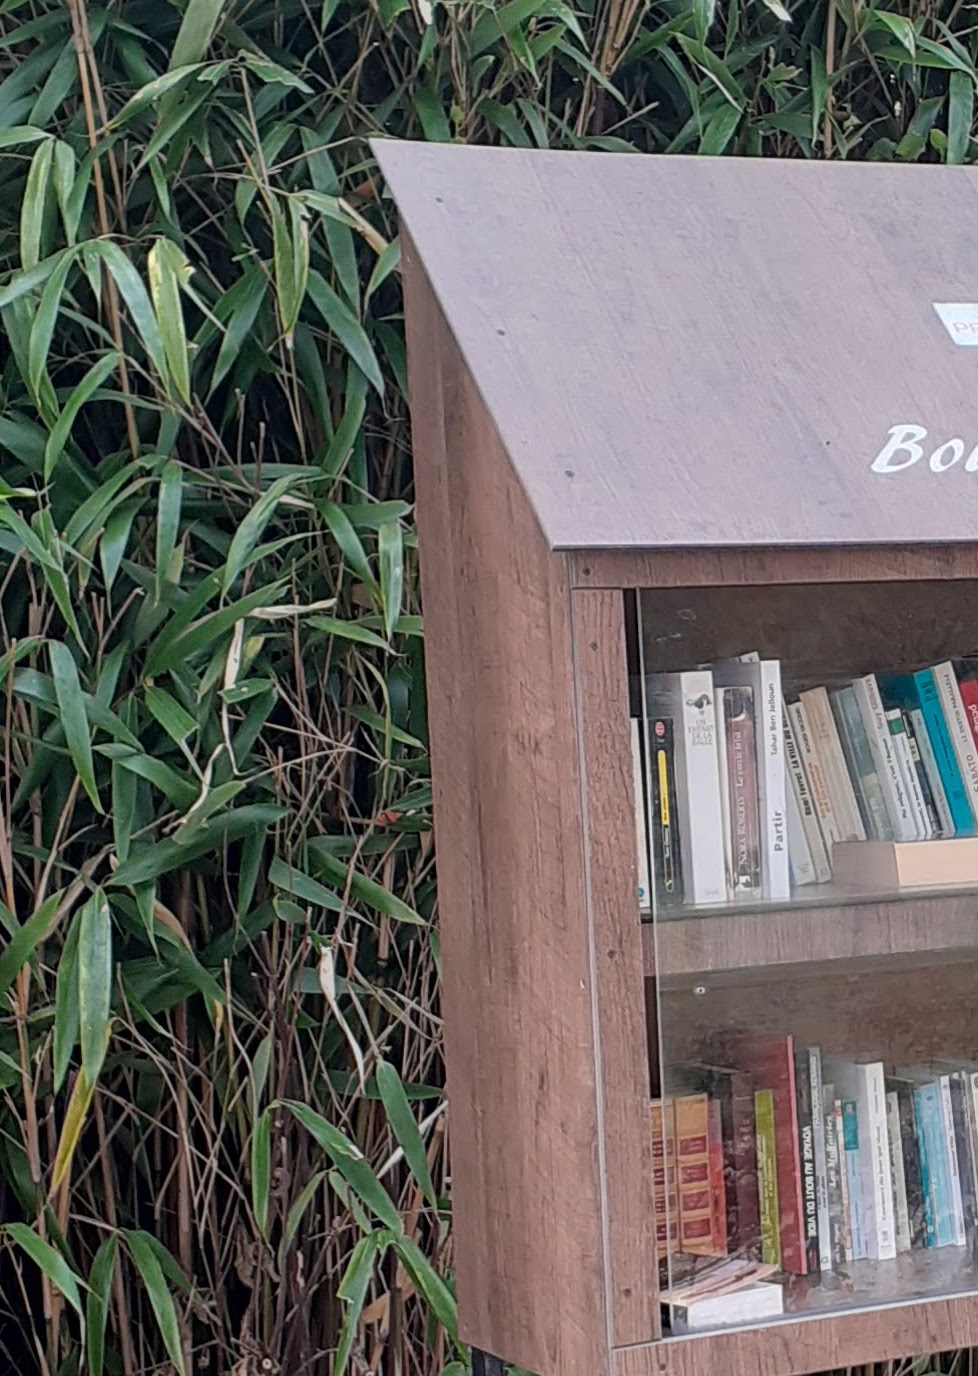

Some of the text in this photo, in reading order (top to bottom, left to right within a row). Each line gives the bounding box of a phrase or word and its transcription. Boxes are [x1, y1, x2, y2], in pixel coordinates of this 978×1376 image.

[773, 810, 784, 852] Partir
[802, 1125, 817, 1237] VOYAGE AU BOUT DU VIDE
